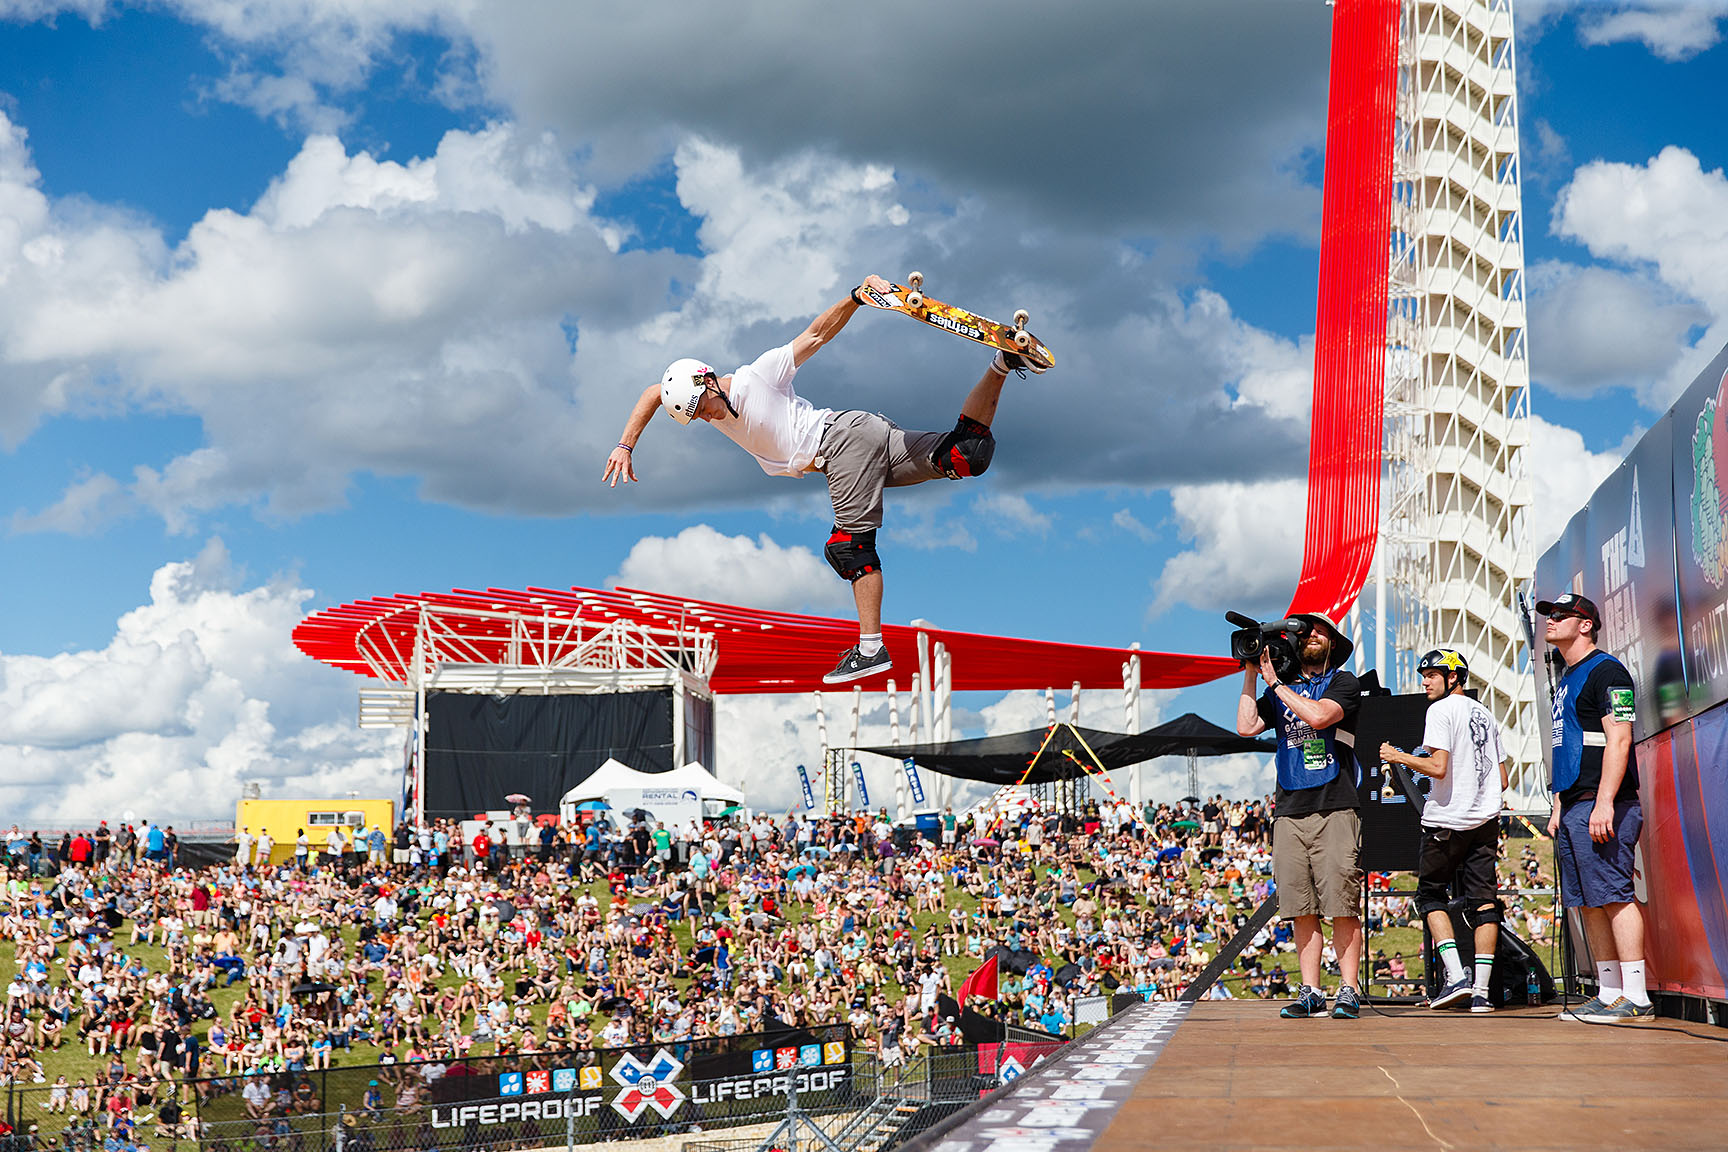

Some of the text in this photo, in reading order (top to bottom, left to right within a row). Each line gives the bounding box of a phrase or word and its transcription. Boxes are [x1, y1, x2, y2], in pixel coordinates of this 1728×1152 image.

[1601, 526, 1628, 598] THE
[1604, 581, 1641, 654] REAL
[1692, 603, 1728, 688] FRUIT
[1326, 753, 1335, 764] 3
[431, 1096, 603, 1129] LIFEPROOF
[691, 1070, 846, 1105] LIFEPROOF
